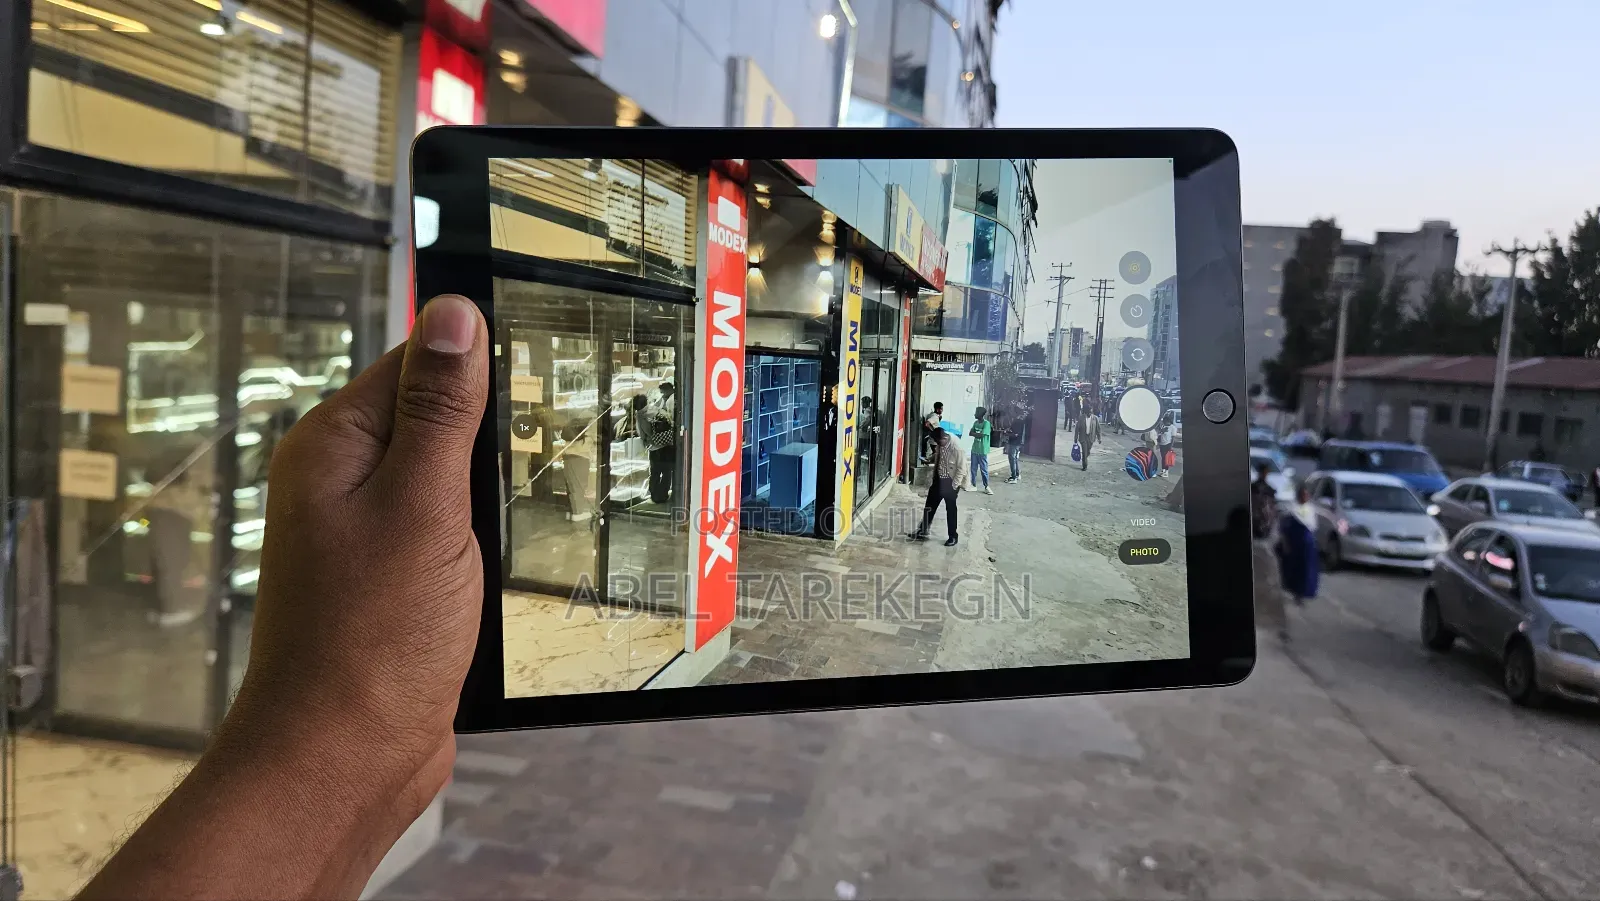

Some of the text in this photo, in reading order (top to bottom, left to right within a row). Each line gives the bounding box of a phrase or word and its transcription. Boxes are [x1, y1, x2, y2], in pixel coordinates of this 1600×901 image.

[709, 222, 747, 254] MODEX
[843, 320, 859, 482] MODEX
[705, 290, 742, 578] MODEX
[1130, 518, 1156, 526] VIDEO
[1130, 547, 1159, 556] PHOTO
